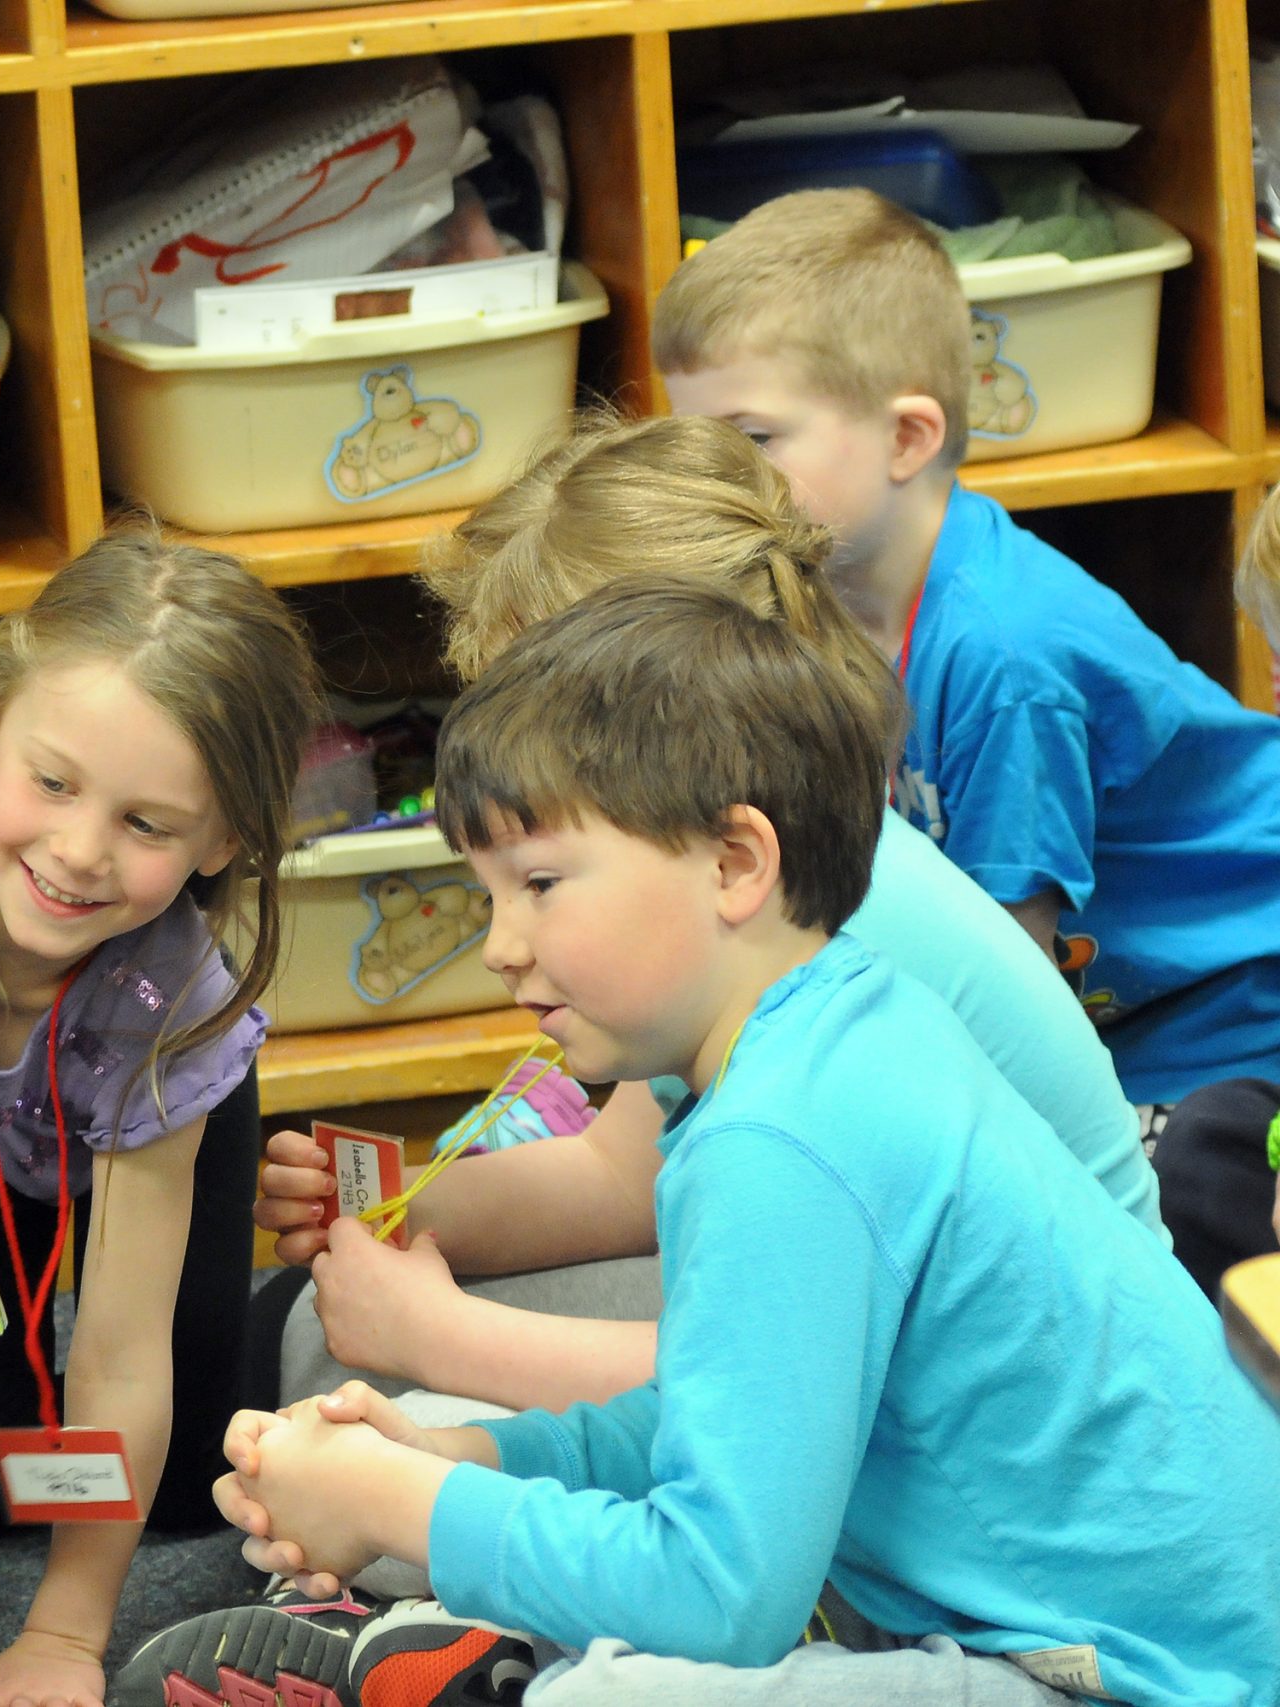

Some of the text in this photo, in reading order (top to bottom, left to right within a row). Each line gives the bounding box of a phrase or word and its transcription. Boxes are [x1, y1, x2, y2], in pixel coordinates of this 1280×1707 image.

[341, 1170, 355, 1205] 2743
[352, 1143, 369, 1215] Isabella Cro
